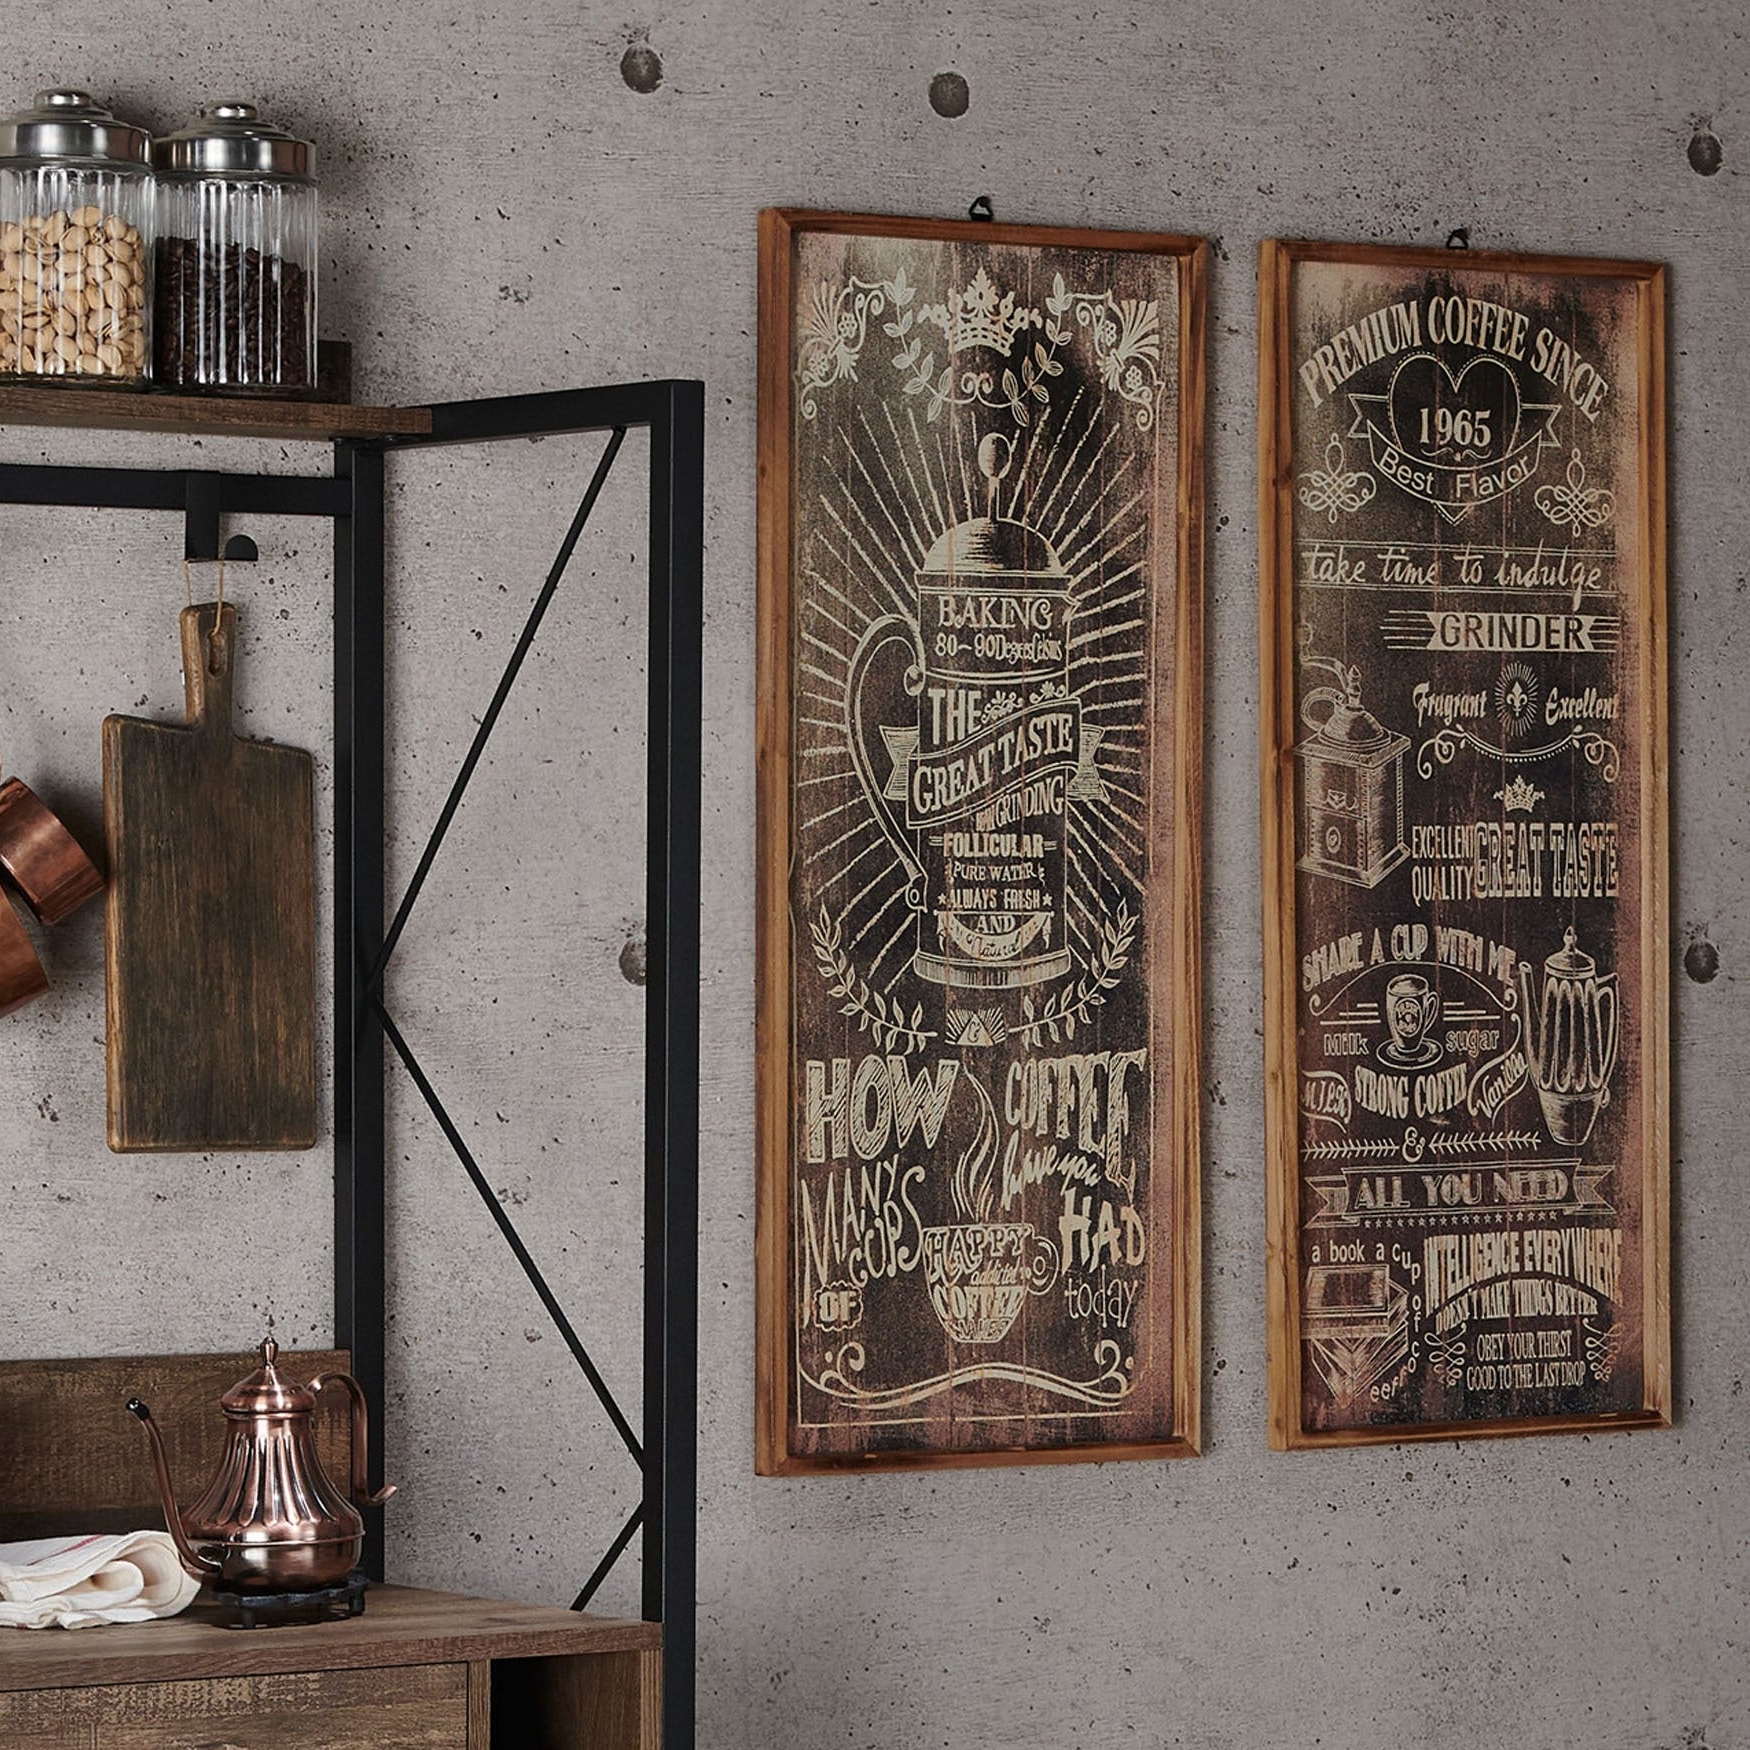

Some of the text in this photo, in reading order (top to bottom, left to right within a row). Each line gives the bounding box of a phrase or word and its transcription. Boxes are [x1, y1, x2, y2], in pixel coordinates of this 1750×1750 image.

[1299, 295, 1609, 423] PREMIUM COFFEE SINCE
[1420, 407, 1491, 447] 1965
[1379, 447, 1529, 498] Best Flavor
[1302, 538, 1602, 611] take time to indulge
[938, 595, 1053, 630] BAKING
[1439, 614, 1584, 650] GRINDER
[927, 688, 981, 745] THE
[1412, 681, 1619, 727] Fragrant Excellent
[913, 713, 1073, 814] GREAT TASTE
[996, 775, 1064, 827] GRINDING
[943, 832, 1045, 858] FOLLICULAR
[1412, 825, 1474, 859] EXCELLENT
[1474, 822, 1619, 898] GREAT TASTE
[953, 861, 1037, 882] PURE WATER
[1412, 866, 1474, 907] QUALITY
[948, 888, 1040, 910] ALWAYS FRESH
[974, 914, 1016, 934] AND
[1370, 928, 1385, 965] A
[1391, 924, 1429, 961] CUP
[1435, 926, 1483, 973] WITH
[1488, 940, 1517, 987] ME
[1446, 1030, 1500, 1058] sugar
[806, 1054, 960, 1163] HOW
[1355, 1065, 1409, 1119] STRONG
[1476, 1051, 1529, 1119] Vanilla
[1005, 1048, 1147, 1206] COFFEE
[1001, 1130, 1102, 1211] have you
[1354, 1168, 1569, 1209] ALL YOU NEED
[801, 1154, 900, 1330] MANY
[849, 1165, 926, 1288] CUPS
[1058, 1186, 1144, 1276] HAD
[925, 1226, 1032, 1288] HAPPY
[1311, 1244, 1321, 1263] a
[1329, 1239, 1366, 1263] book
[1375, 1242, 1385, 1261] a
[1391, 1243, 1421, 1285] cup
[1424, 1231, 1520, 1318] INTELLIGENCE
[818, 1290, 857, 1323] OF
[1064, 1264, 1138, 1328] today
[1512, 1279, 1553, 1318] THINGS
[1476, 1329, 1573, 1361] OBEY YOUR THIRST
[1466, 1360, 1587, 1391] GOOD TO THE LAST DROP
